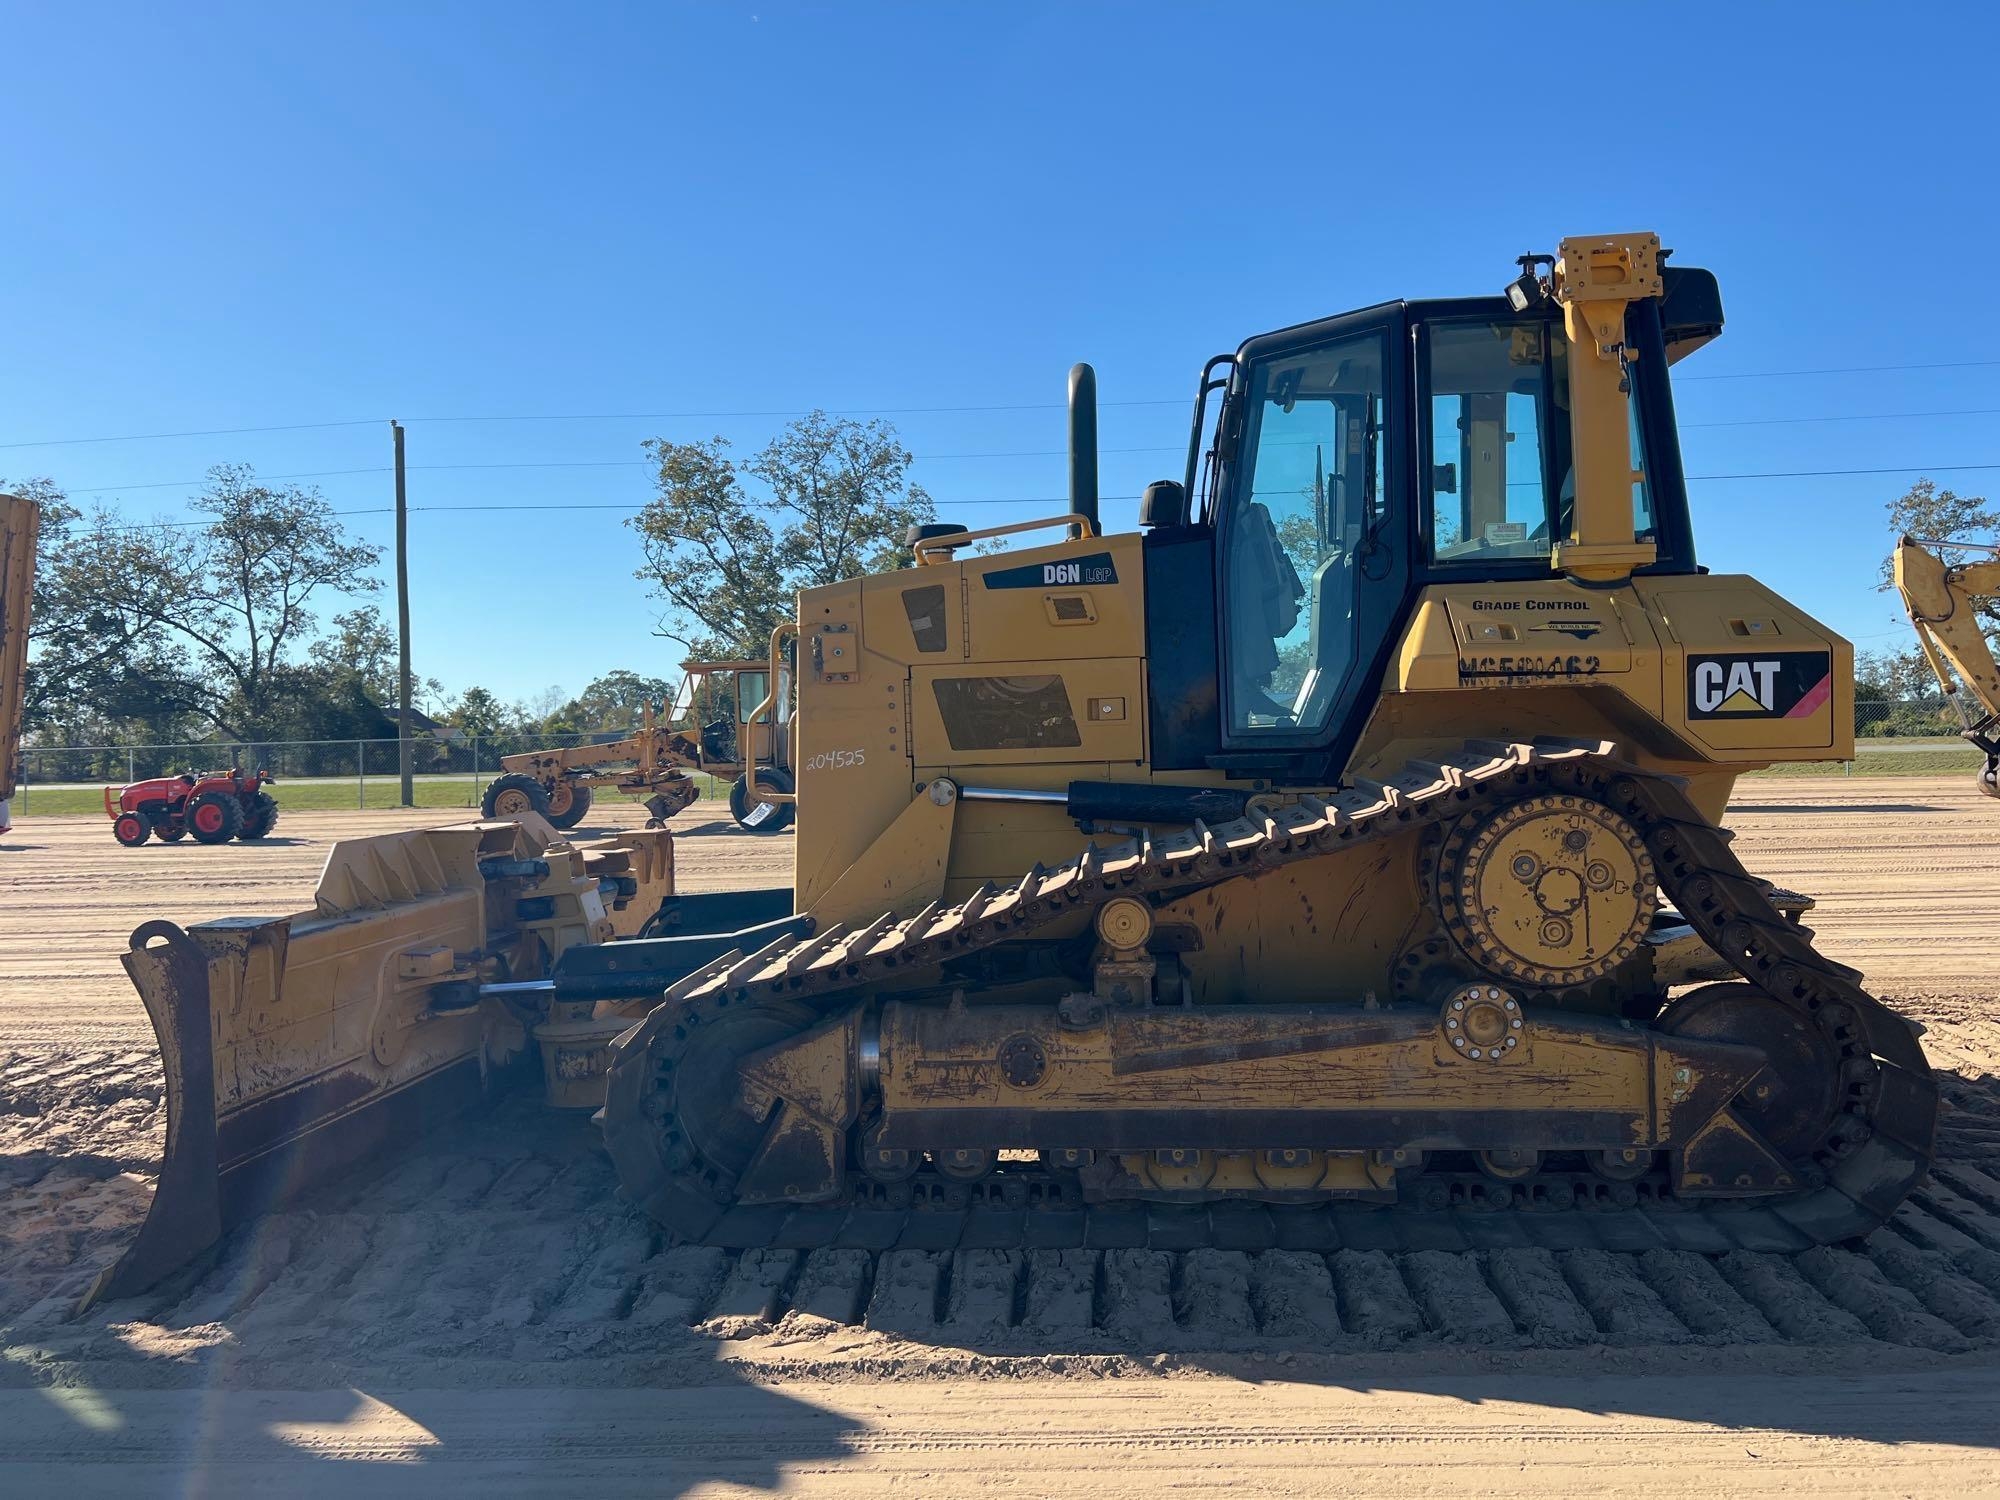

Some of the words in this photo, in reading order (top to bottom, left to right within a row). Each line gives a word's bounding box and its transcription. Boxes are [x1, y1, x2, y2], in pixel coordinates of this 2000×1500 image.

[1043, 563, 1080, 584] D6N
[1085, 567, 1112, 583] LGP
[1472, 600, 1521, 611] GRADE
[1525, 600, 1590, 611] CONTROL
[1695, 661, 1781, 713] CAT
[806, 748, 865, 771] 204525
